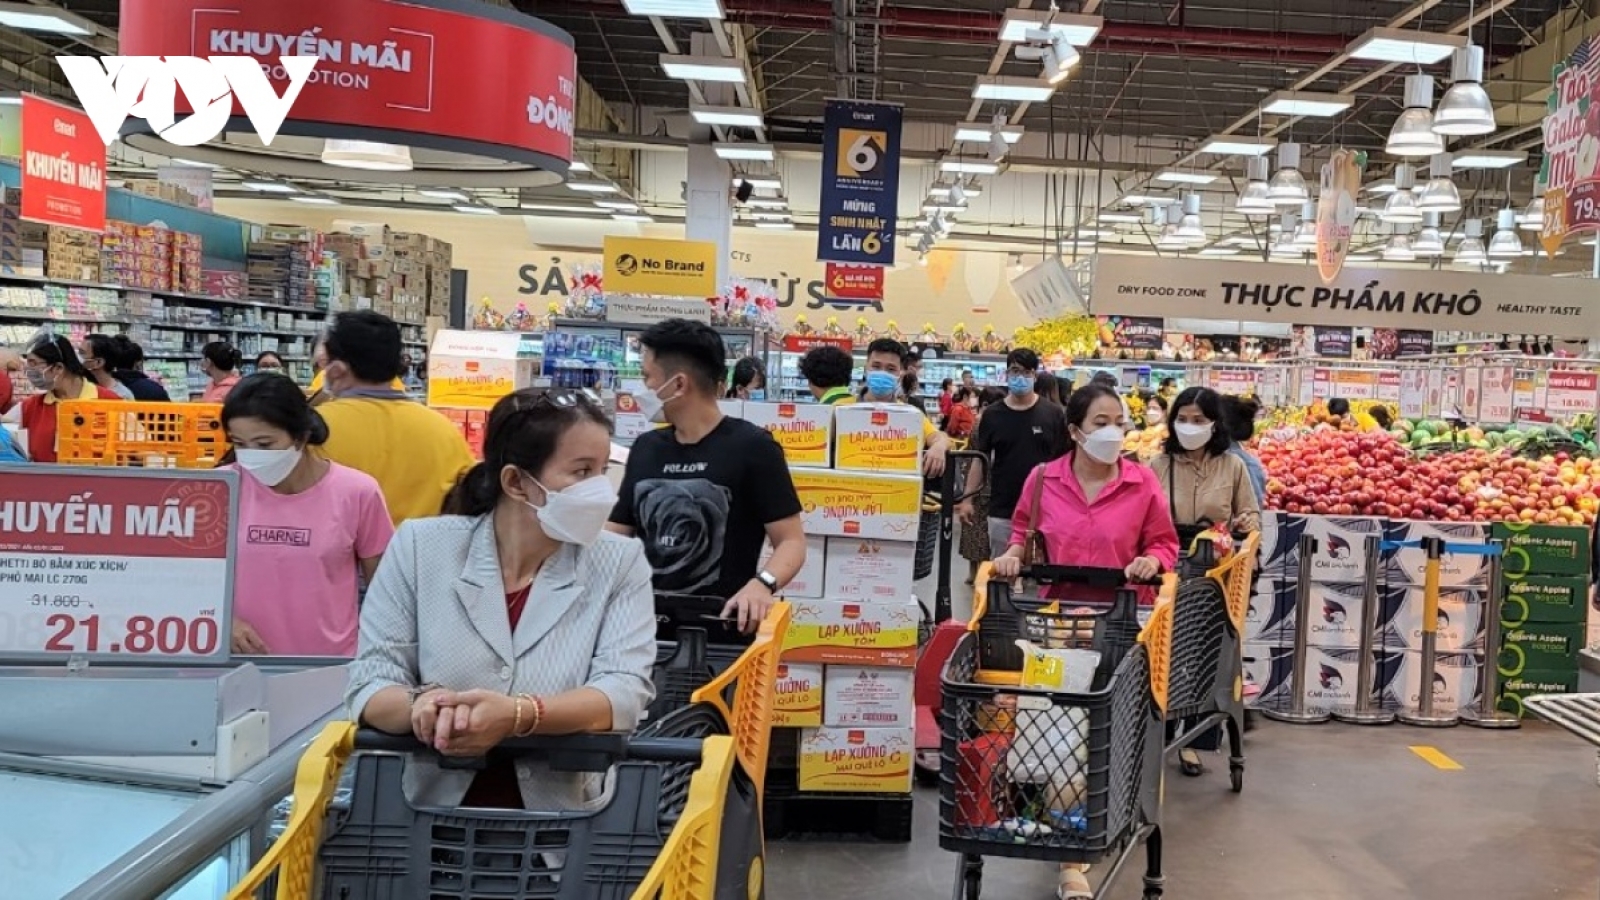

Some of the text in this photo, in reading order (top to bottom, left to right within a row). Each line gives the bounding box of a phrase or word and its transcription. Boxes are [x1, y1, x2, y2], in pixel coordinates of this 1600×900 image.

[210, 27, 411, 72] KHUYẾN MÃI
[259, 64, 369, 89] ROOTION
[1545, 107, 1584, 148] Gala
[846, 134, 878, 172] 6
[26, 150, 103, 192] KHUYẾN MÃI
[843, 199, 876, 213] MỪNG
[830, 215, 887, 230] SINH NHẬT
[832, 231, 881, 255] LẦN 6
[642, 258, 705, 272] No Brand
[518, 256, 569, 296] SẢ
[1117, 284, 1207, 298] DRY FOOD ZONE
[1221, 280, 1482, 315] THỰC PHẨM KHÔ
[1497, 303, 1582, 316] HEALTHY TASTE
[663, 462, 708, 473] FOLLOW
[125, 498, 196, 538] MÃI
[249, 528, 308, 543] CHARNEL
[1512, 535, 1572, 546] Organic Apples
[24, 573, 44, 583] MAI
[47, 573, 60, 584] LC
[62, 574, 88, 584] 270G
[1509, 584, 1571, 595] Organic Apples
[31, 593, 80, 607] 31.800
[45, 613, 218, 655] 21.800
[1506, 632, 1568, 642] Organic Apples
[1538, 683, 1566, 691] Apples
